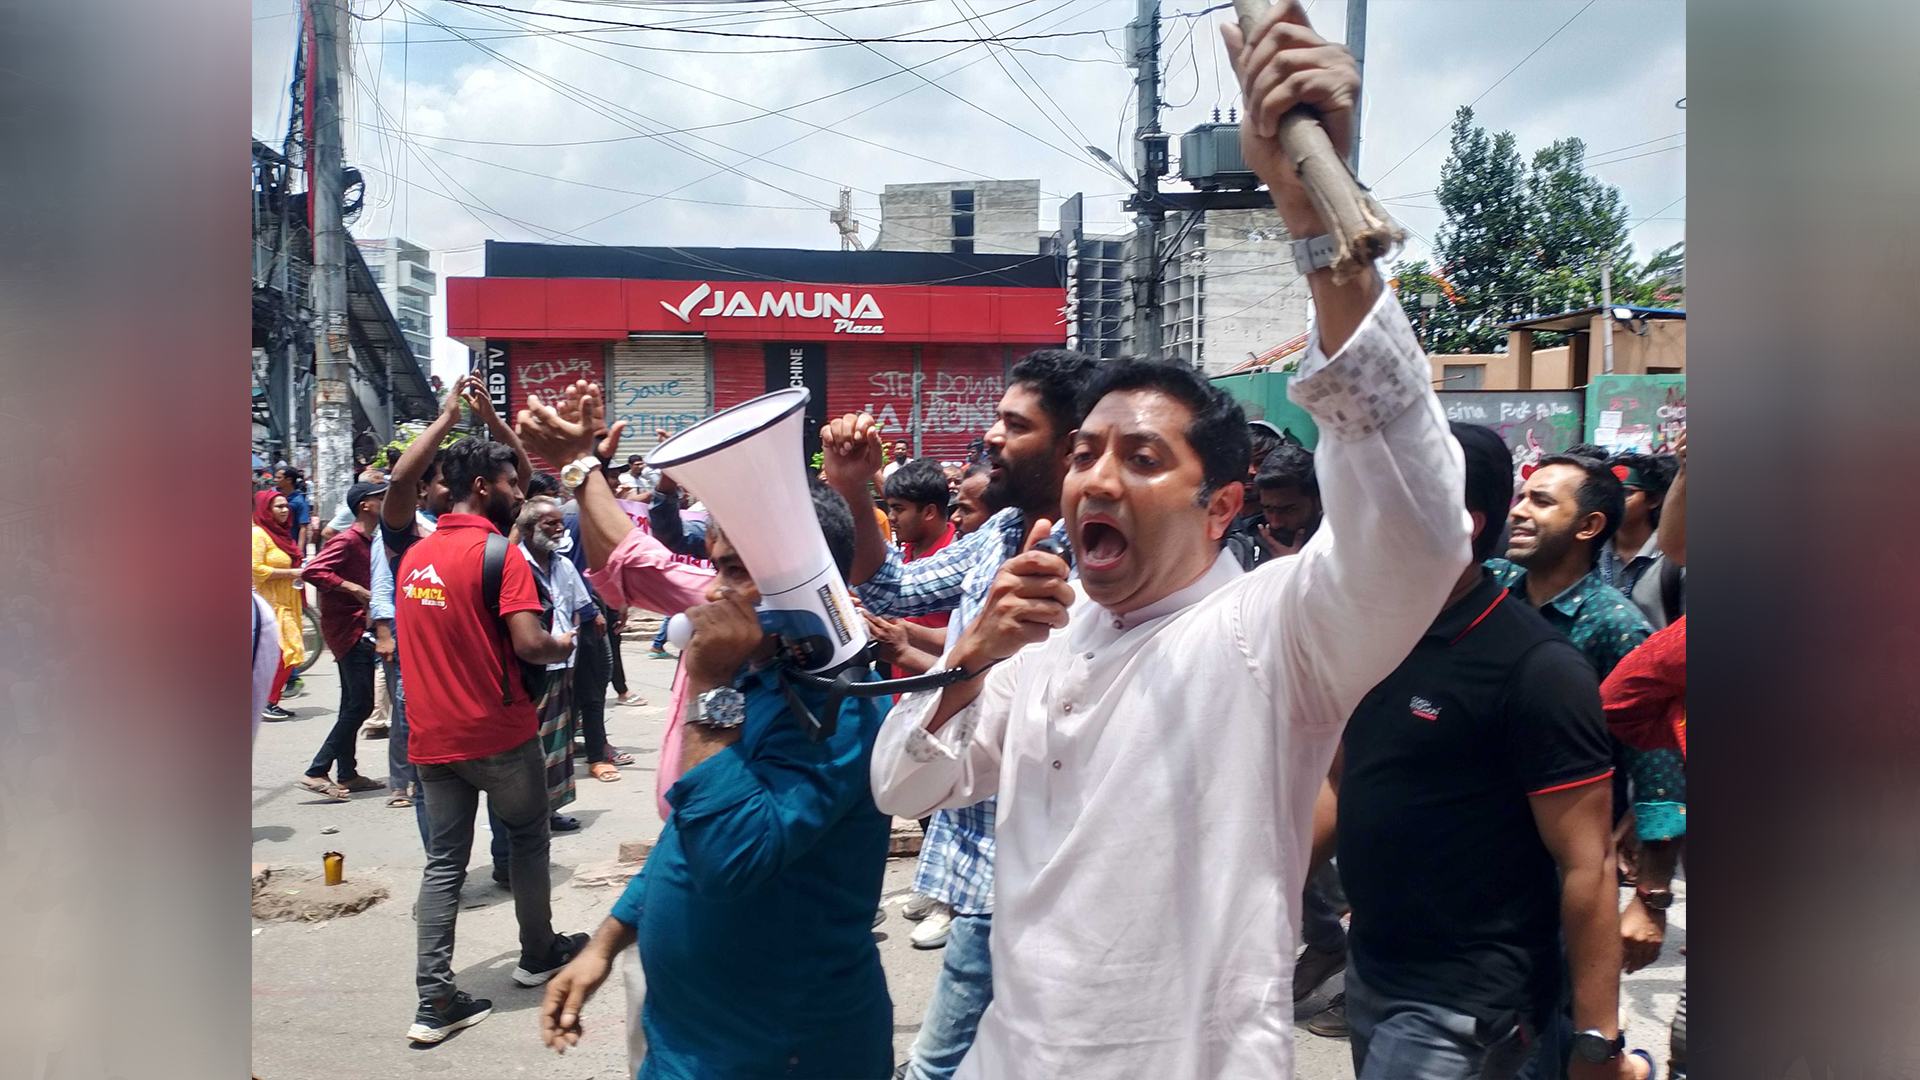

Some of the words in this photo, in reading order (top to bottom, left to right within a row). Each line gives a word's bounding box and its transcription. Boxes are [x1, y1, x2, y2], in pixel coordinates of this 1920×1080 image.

[699, 291, 884, 319] JAMUNA
[832, 318, 885, 334] Plaza
[488, 347, 505, 370] TV
[789, 348, 804, 389] CHINE
[517, 358, 596, 389] KILLER
[868, 370, 926, 396] STEP
[489, 373, 506, 405] LED
[619, 381, 683, 405] Save
